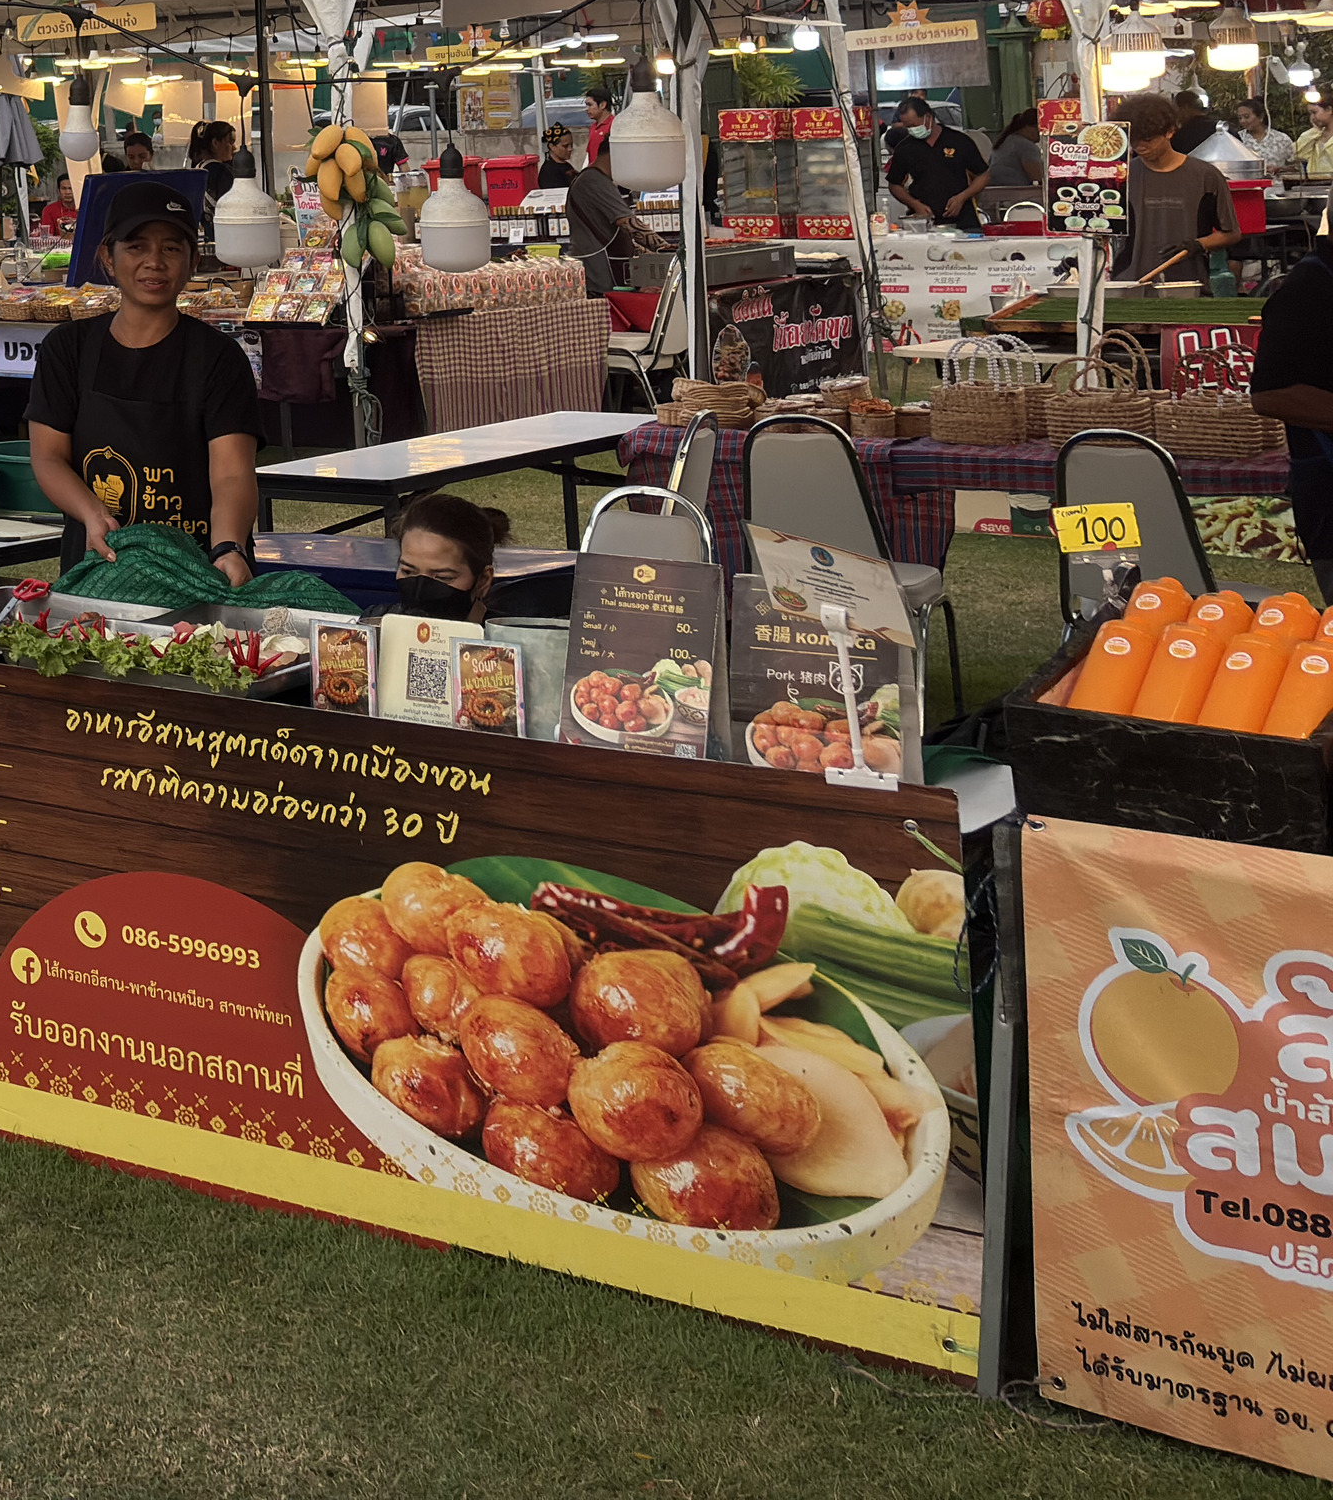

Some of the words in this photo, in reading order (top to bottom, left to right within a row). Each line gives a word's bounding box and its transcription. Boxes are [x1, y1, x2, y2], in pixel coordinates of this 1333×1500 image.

[1050, 142, 1090, 156] Gyoza
[1075, 202, 1099, 210] Sauce
[142, 466, 174, 483] พา
[142, 485, 183, 511] ข้าว
[1076, 516, 1126, 546] 100
[614, 587, 672, 603] ไส้กรอกอีสาน
[600, 598, 616, 606] Thai
[618, 601, 650, 611] sausage
[583, 622, 601, 630] Small
[676, 623, 699, 634] 50.-
[755, 624, 791, 644] 香腸
[795, 631, 877, 651] колса
[580, 648, 600, 657] Large
[669, 648, 697, 660] 100.-
[471, 657, 497, 674] Sour
[767, 668, 795, 681] Pork
[801, 669, 826, 684] 猪肉
[384, 807, 424, 839] 30
[436, 810, 460, 844] ปี
[121, 924, 261, 969] 086-5996993
[44, 958, 214, 1011] ไส้กรอกอีสาน-พาข้าวเหนียว
[218, 996, 293, 1027] สาขาพัทยา
[10, 1000, 304, 1100] รับออกงานนอกสถานที่
[1264, 1077, 1333, 1126] น้ำส้
[1071, 1300, 1255, 1374] ไม่ใส่สารกันบูด
[1075, 1346, 1264, 1417] ได้รับมาตรฐาน
[1274, 1407, 1315, 1433] อย.
